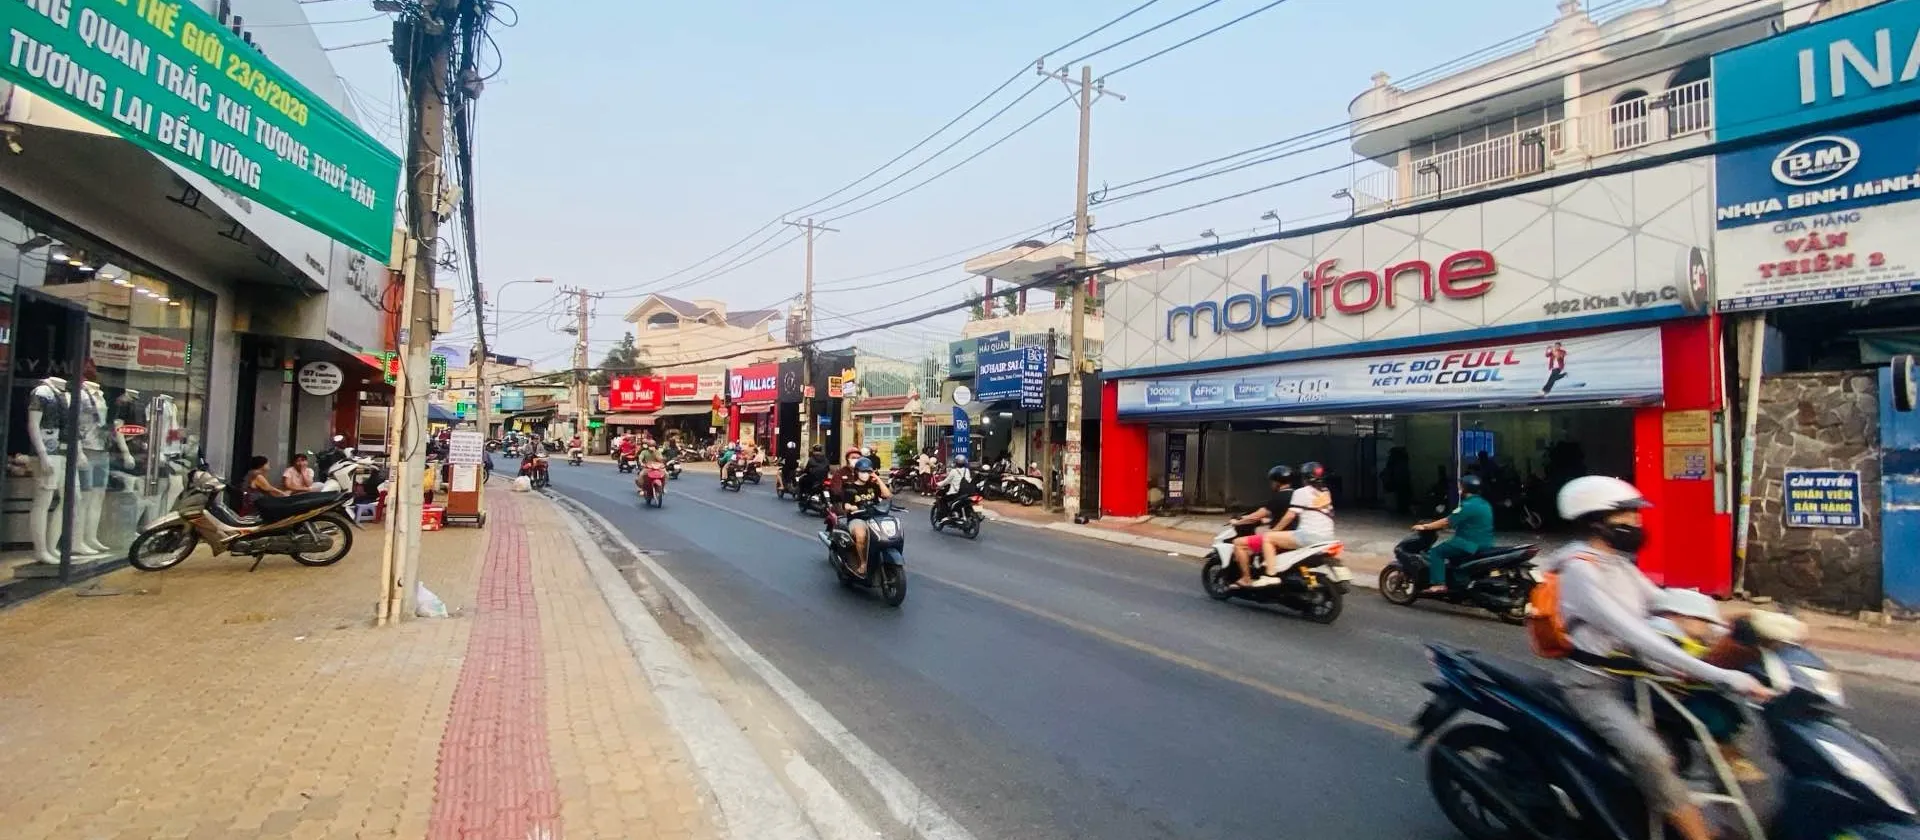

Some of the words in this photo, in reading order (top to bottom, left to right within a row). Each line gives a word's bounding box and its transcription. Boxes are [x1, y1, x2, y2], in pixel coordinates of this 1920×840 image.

[182, 22, 225, 69] GIỚI
[226, 54, 309, 126] 23/3/2026
[10, 28, 107, 110] TƯƠNG
[112, 87, 153, 133] LAI
[158, 111, 205, 161] BỀN
[209, 140, 262, 190] VỮNG
[79, 8, 150, 76] QUAN
[157, 54, 212, 113] TRẮC
[217, 93, 251, 136] KHÍ
[256, 117, 309, 170] TƯỢNG
[349, 177, 376, 210] VĂN
[1790, 147, 1843, 171] BM
[1718, 198, 1783, 220] NHỰA
[1773, 218, 1807, 234] CỬA
[1813, 211, 1862, 229] HÀNG
[1758, 252, 1855, 279] THIÊN
[1867, 251, 1886, 267] 2
[1166, 249, 1497, 342] mobifone
[1583, 295, 1619, 310] Kha
[1621, 289, 1657, 307] Vạn
[1368, 361, 1406, 375] TỐC
[1410, 357, 1440, 372] ĐỘ
[1441, 350, 1520, 370] FULL
[743, 376, 776, 391] WALLACE
[1372, 374, 1402, 387] KẾT
[1406, 373, 1433, 385] NỐI
[1435, 368, 1505, 385] COOL
[1790, 474, 1814, 487] CẦN
[1791, 488, 1824, 499] NHÂN
[1826, 489, 1853, 499] VIÊN
[1794, 501, 1818, 512] BÁN
[1820, 501, 1852, 512] HÀNG
